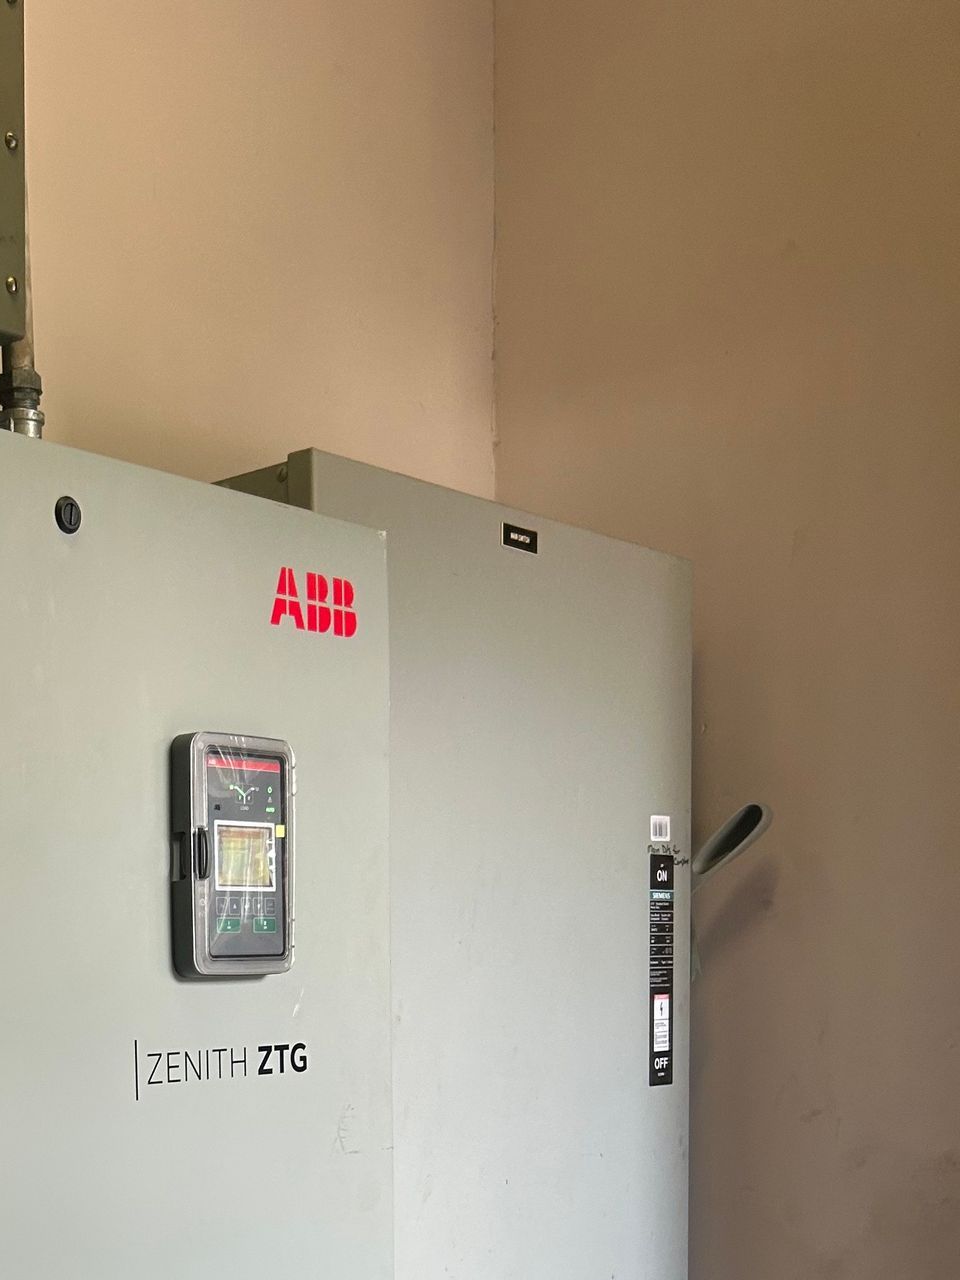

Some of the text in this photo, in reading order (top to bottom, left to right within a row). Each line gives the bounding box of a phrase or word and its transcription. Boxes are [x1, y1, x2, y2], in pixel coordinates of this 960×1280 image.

[270, 566, 358, 638] ABB
[656, 869, 668, 882] ON
[652, 892, 671, 900] SIEMENS
[146, 1042, 308, 1085] ZENITH ZTG
[654, 1057, 669, 1070] OFF
